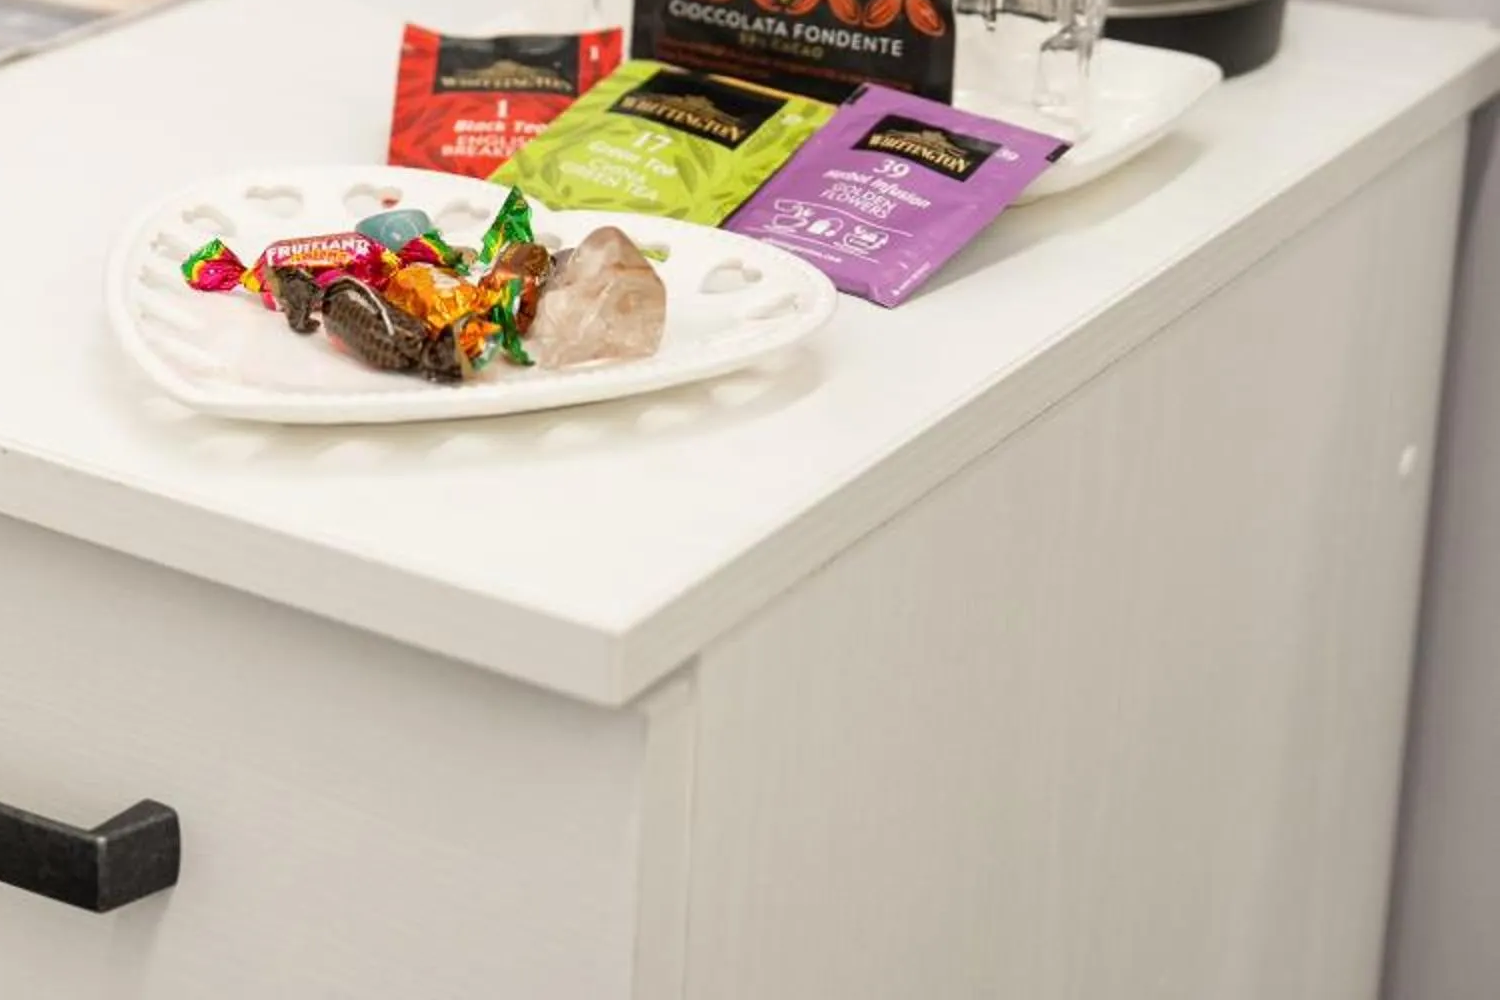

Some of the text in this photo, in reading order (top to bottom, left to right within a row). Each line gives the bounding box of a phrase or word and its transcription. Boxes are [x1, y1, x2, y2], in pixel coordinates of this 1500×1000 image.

[793, 23, 904, 58] FONDENTE
[632, 130, 673, 154] 17
[868, 133, 971, 173] WHITTINGTON
[872, 158, 911, 179] 39
[819, 189, 889, 219] FLOWERS
[266, 239, 371, 266] FRUITLAND
